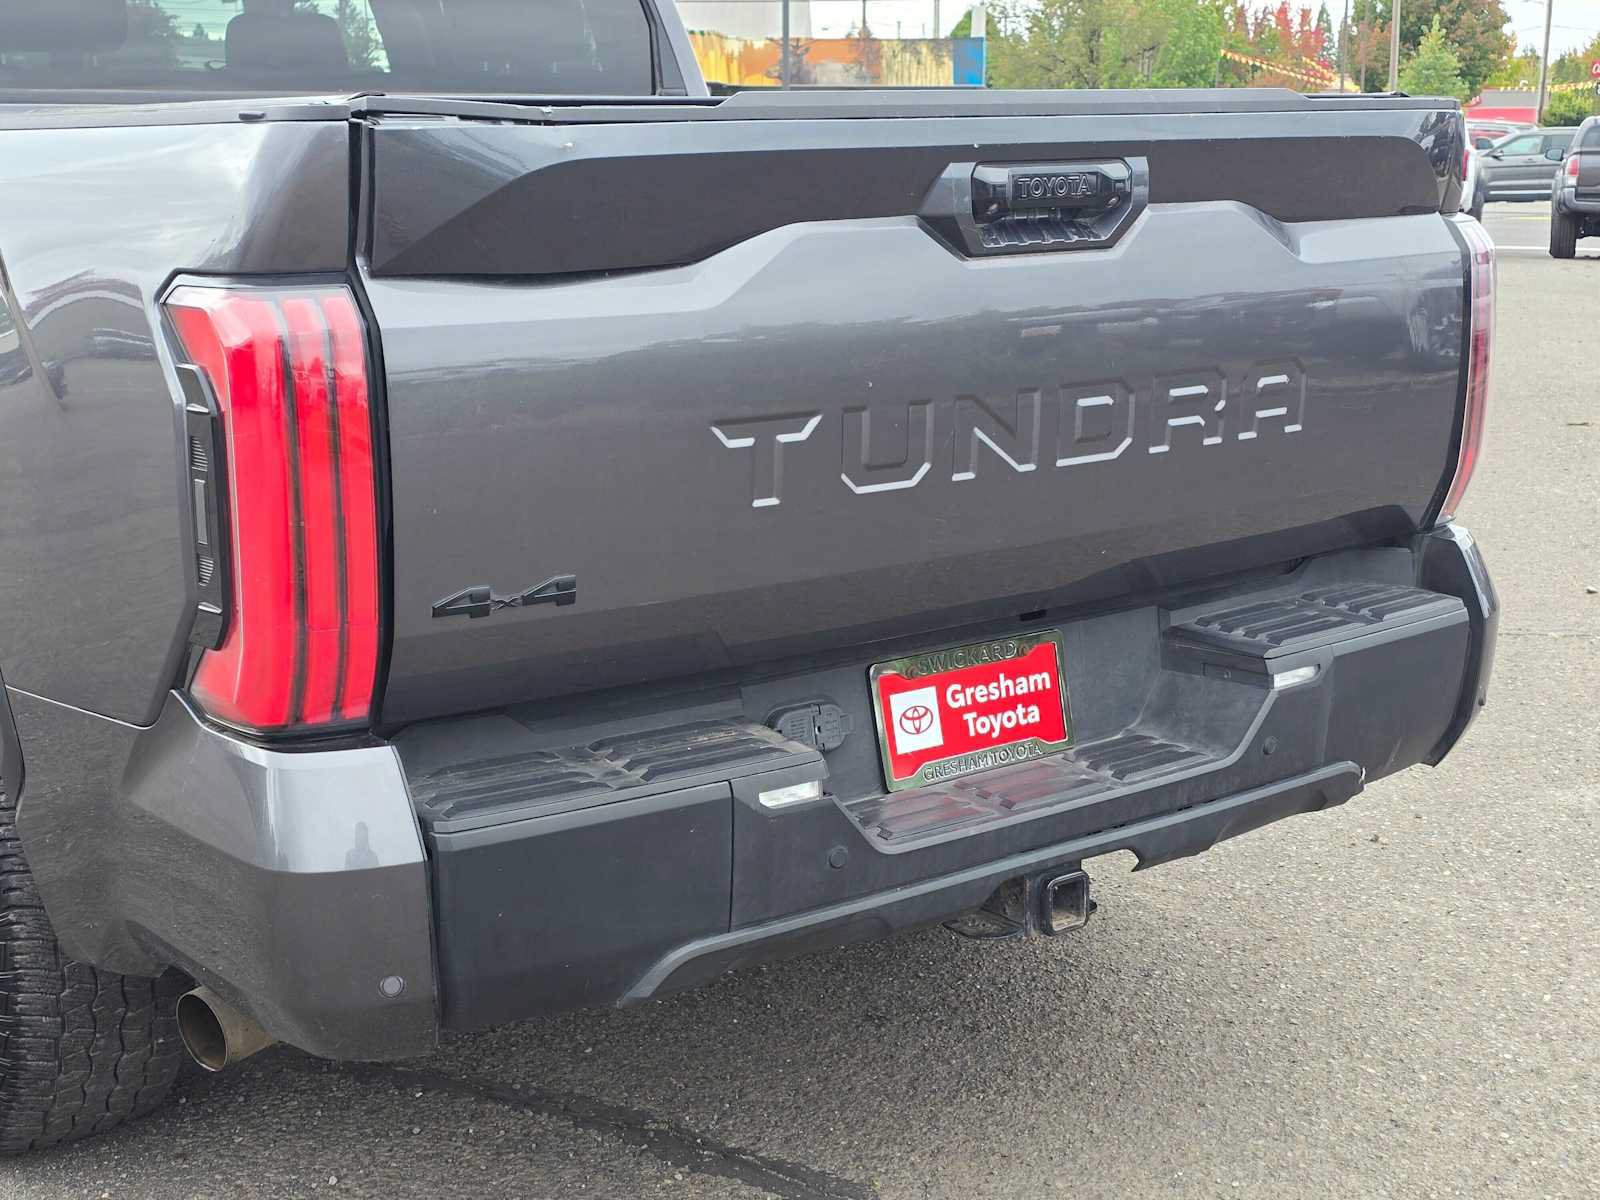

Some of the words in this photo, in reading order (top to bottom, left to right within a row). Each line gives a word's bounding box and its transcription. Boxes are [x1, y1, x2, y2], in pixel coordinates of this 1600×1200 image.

[1018, 176, 1091, 197] TOYOTA
[711, 358, 1306, 508] TUNDRA
[918, 641, 1017, 673] SWICKARD
[946, 672, 1051, 708] Gresham
[963, 703, 1041, 738] Toyota
